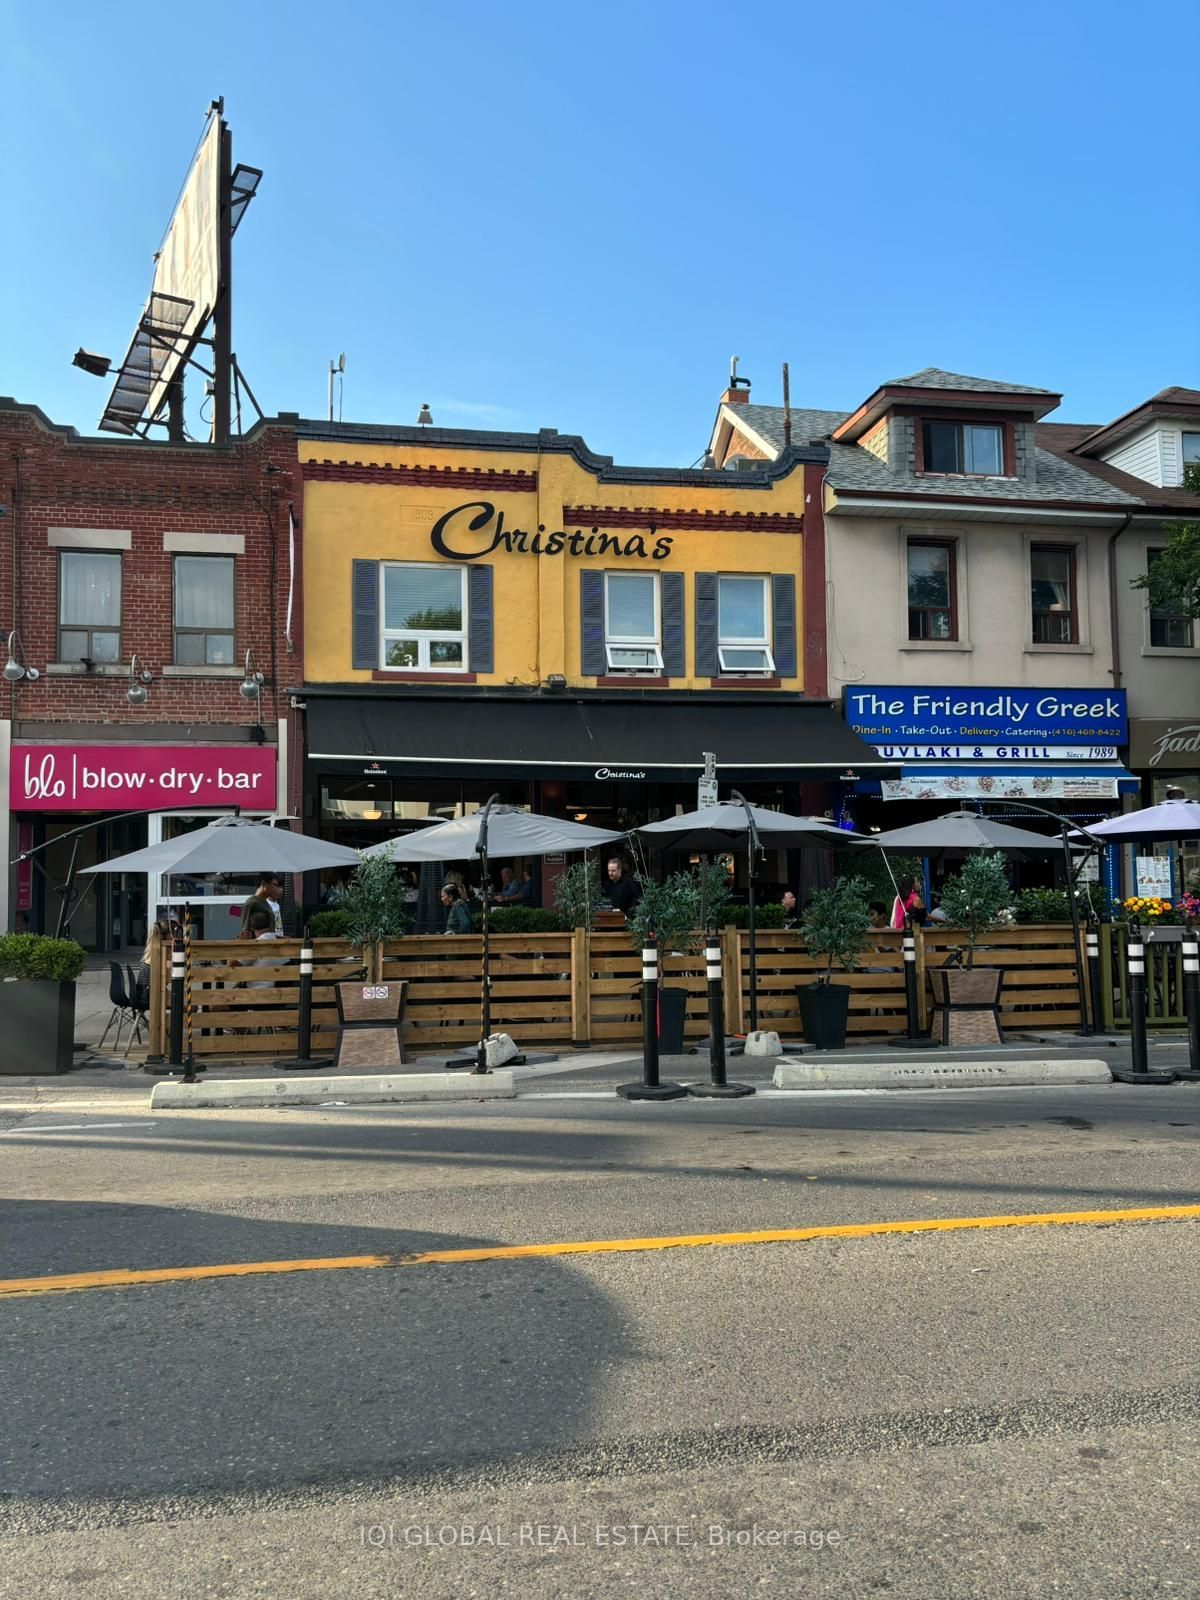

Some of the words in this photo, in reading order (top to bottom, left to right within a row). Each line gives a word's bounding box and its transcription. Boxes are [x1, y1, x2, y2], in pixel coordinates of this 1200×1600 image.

[430, 501, 673, 560] Christina's
[852, 694, 905, 715] The
[913, 695, 1029, 722] Friendly
[1036, 696, 1120, 718] Greek
[900, 725, 952, 735] Take-Out
[960, 727, 1000, 737] Delivery
[1005, 727, 1048, 738] Catering
[973, 746, 984, 758] &
[996, 747, 1050, 758] GRILL
[1088, 747, 1114, 758] 1989
[24, 753, 66, 799] blo
